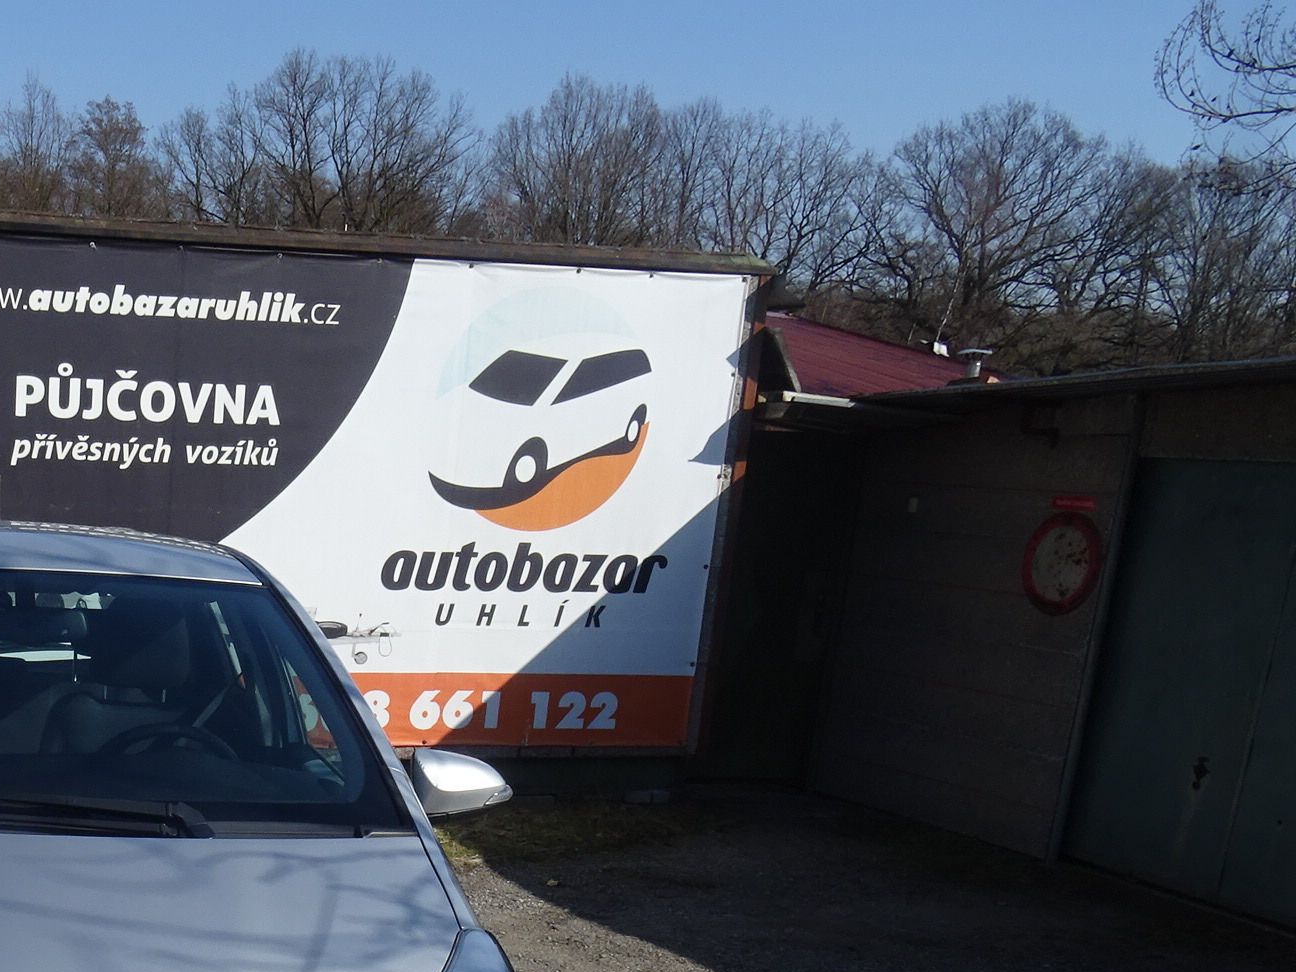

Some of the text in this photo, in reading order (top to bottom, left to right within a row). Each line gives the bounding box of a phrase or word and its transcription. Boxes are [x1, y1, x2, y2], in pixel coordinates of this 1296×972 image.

[14, 362, 281, 426] PŮJČOVNA
[10, 433, 280, 469] přívěsných vozíků
[380, 541, 668, 594] autobazar
[435, 599, 607, 628] UHLÍK
[409, 689, 502, 730] 661
[530, 691, 619, 730] 122
